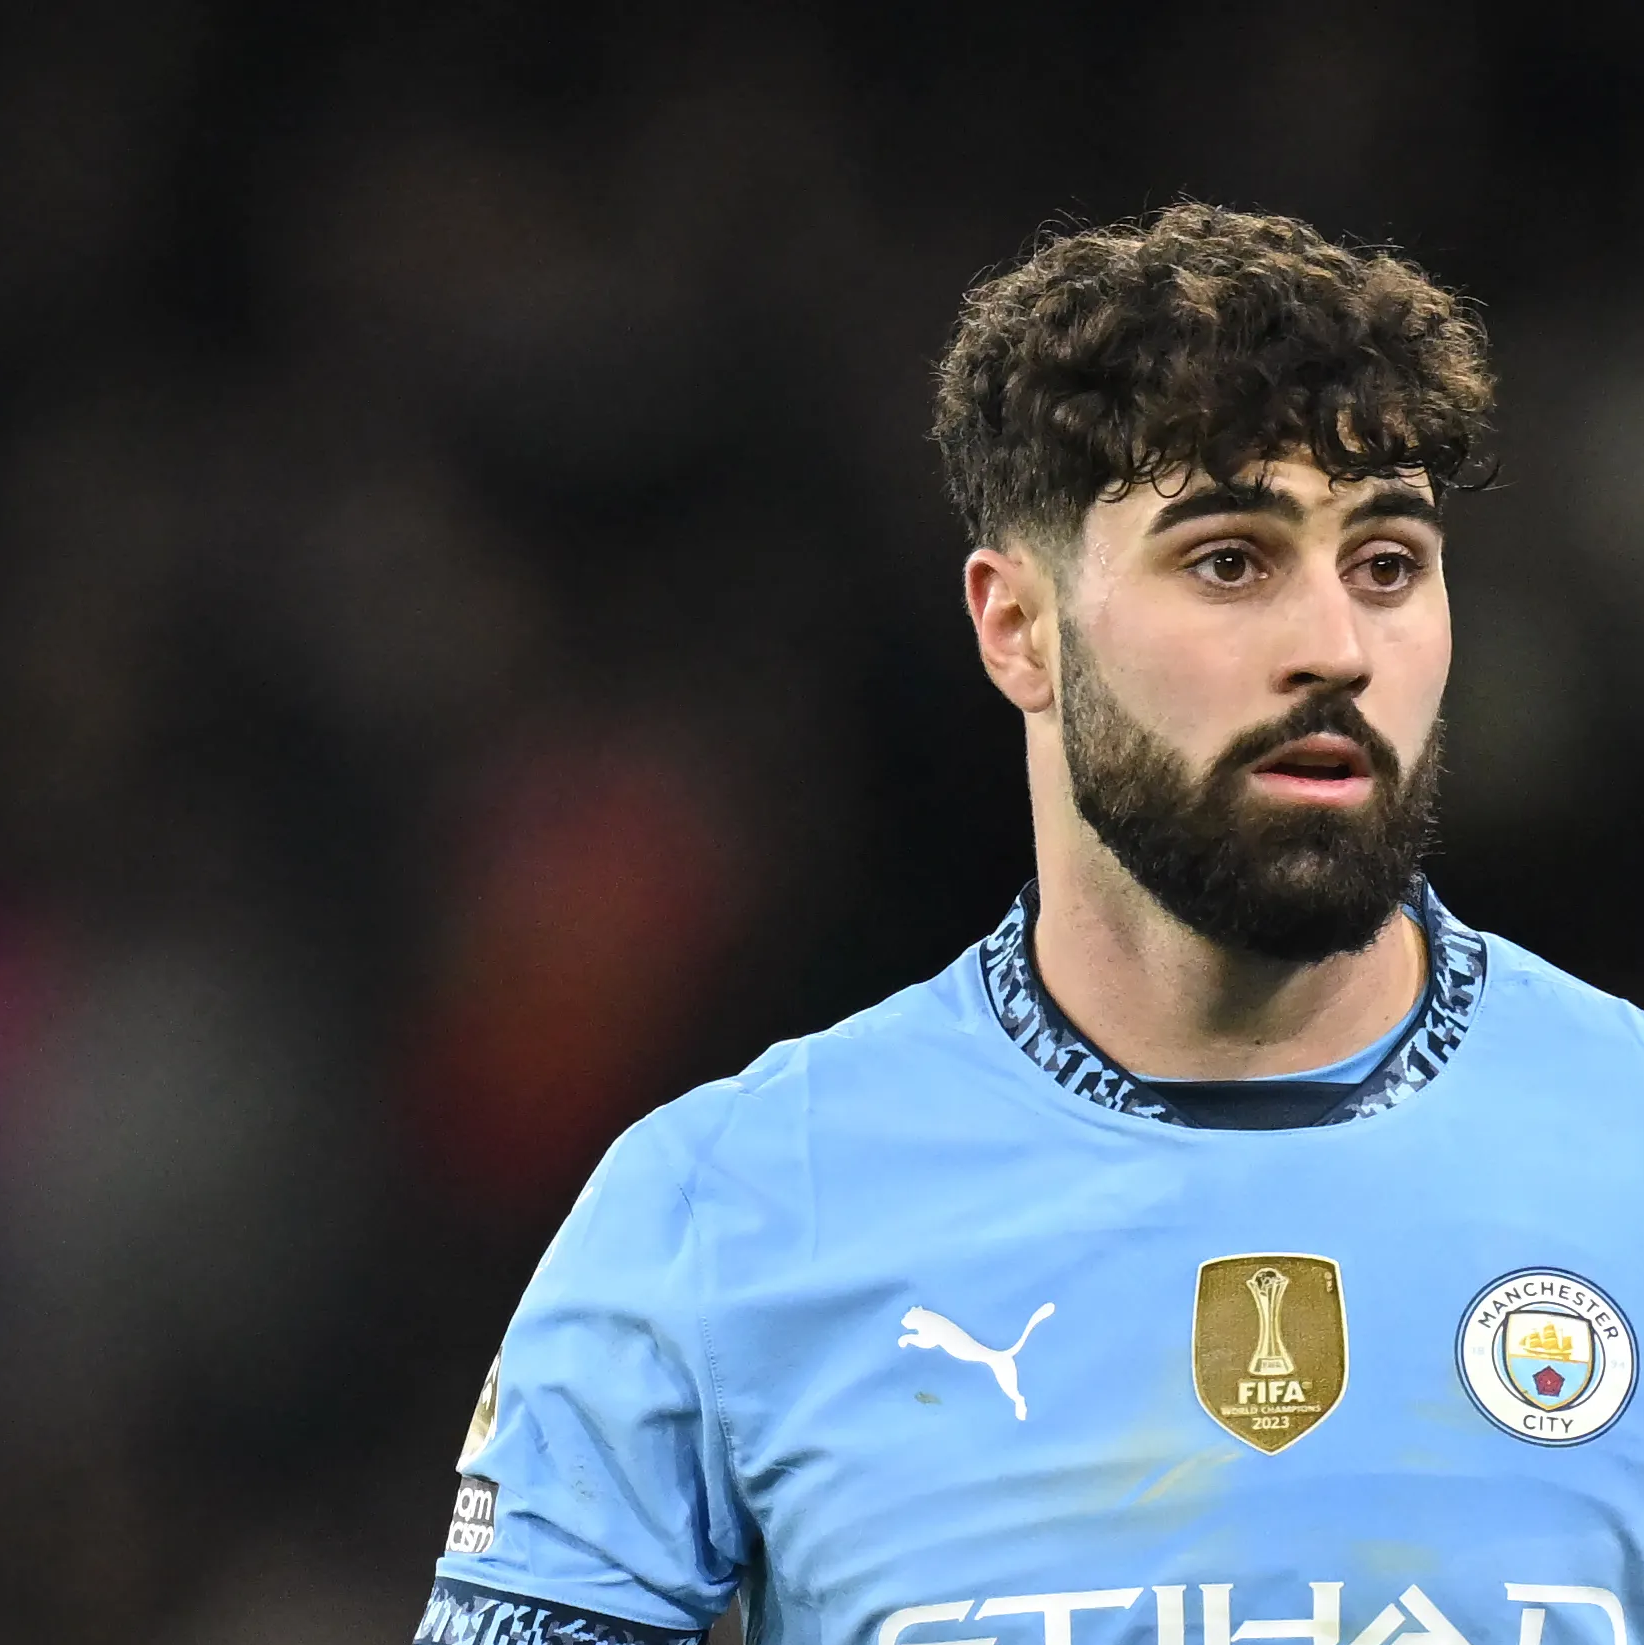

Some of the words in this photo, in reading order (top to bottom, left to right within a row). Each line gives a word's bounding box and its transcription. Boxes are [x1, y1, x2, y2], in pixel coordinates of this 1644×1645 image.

[1478, 1281, 1619, 1340] MANCHESTER
[1238, 1380, 1306, 1405] FIFA
[1220, 1405, 1258, 1416] WORLD
[1261, 1404, 1322, 1415] CHAMPIONS
[1252, 1416, 1290, 1430] 2023
[1523, 1414, 1574, 1434] CITY
